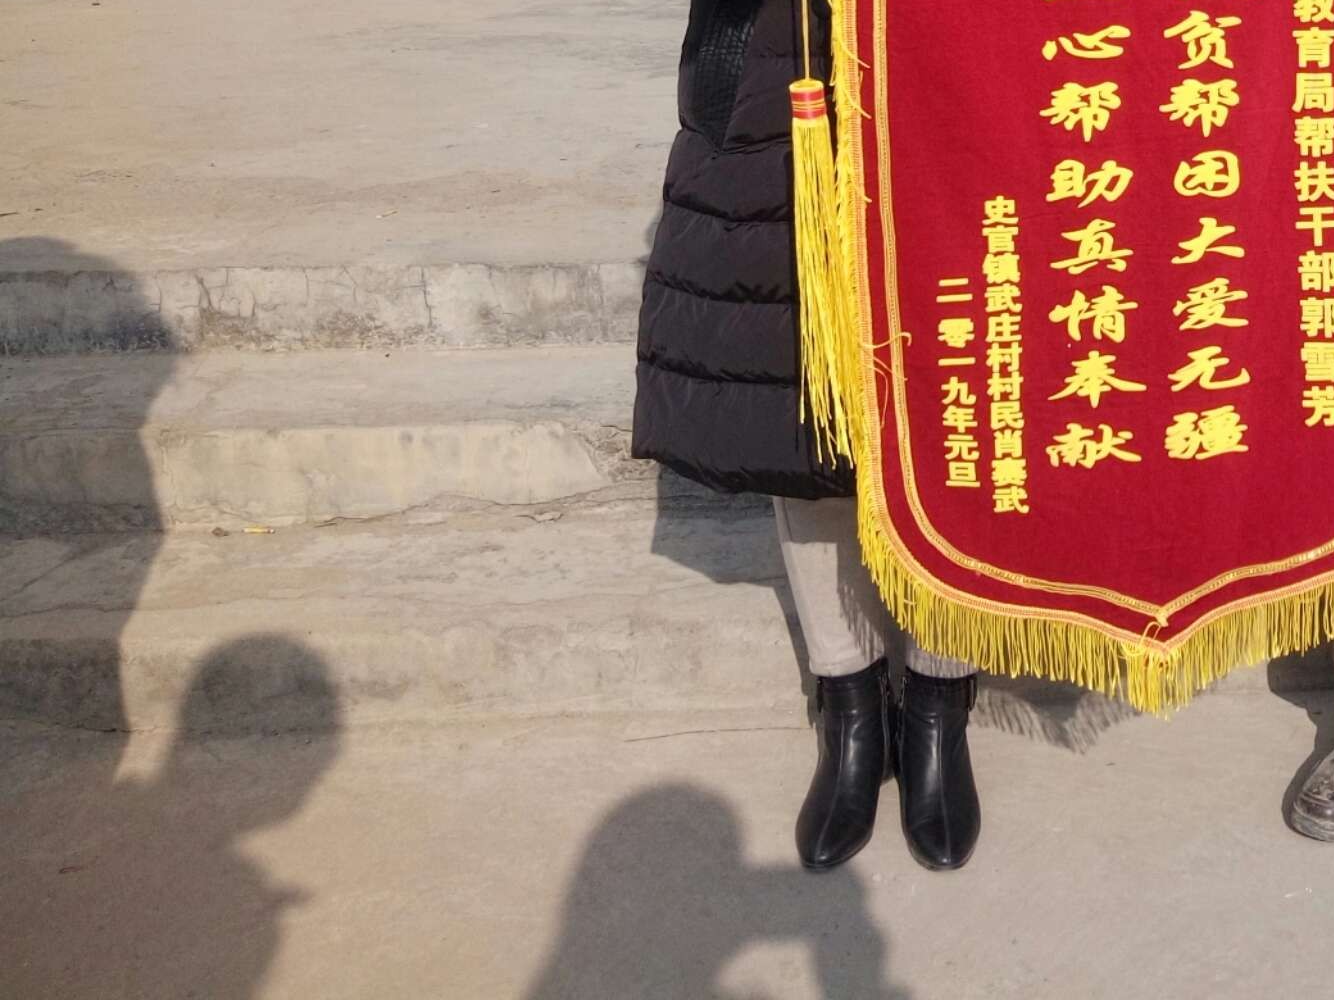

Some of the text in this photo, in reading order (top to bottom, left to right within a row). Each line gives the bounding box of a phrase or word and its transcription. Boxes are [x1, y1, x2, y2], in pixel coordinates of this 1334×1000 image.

[936, 277, 980, 488] 二零一九年元旦
